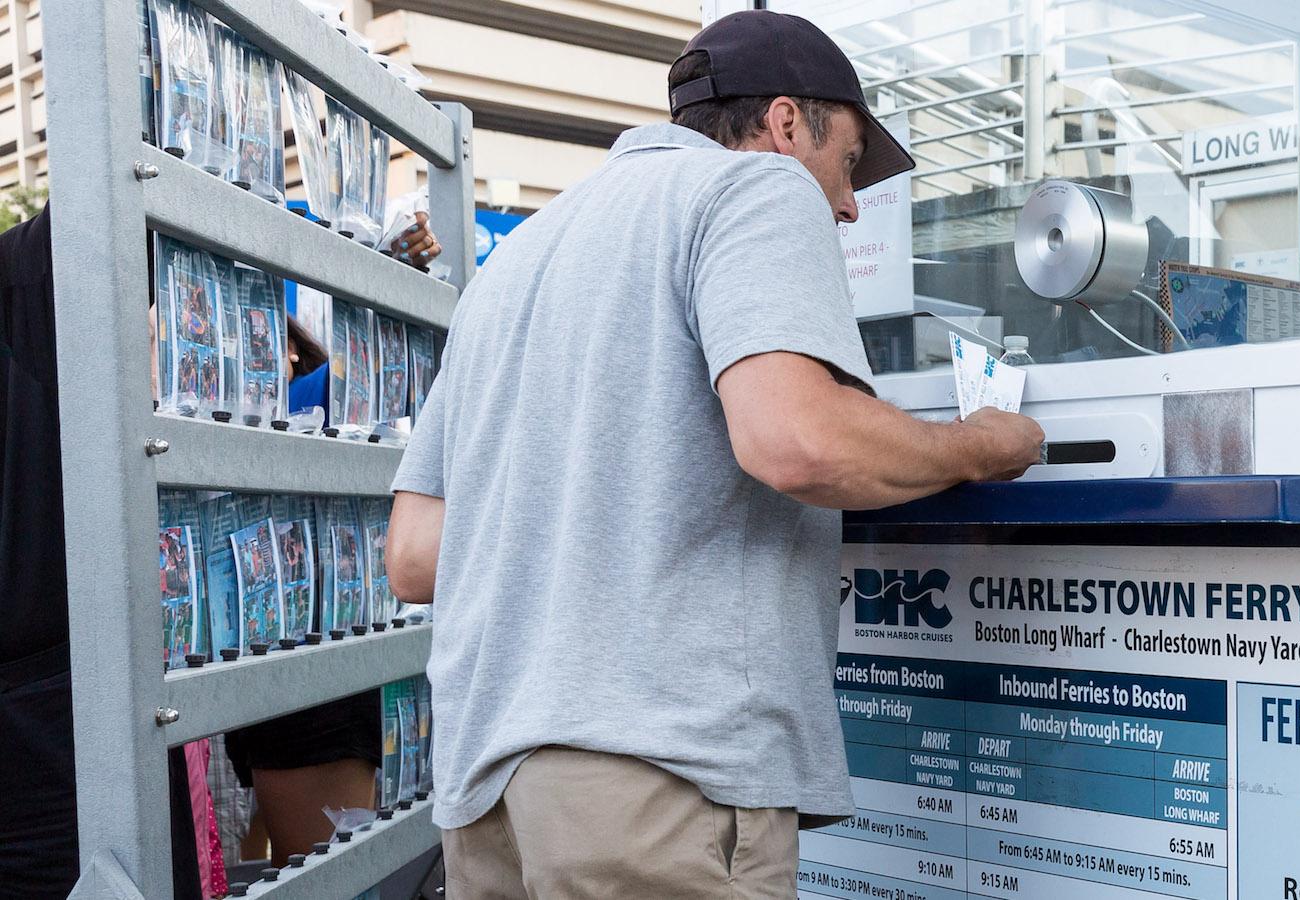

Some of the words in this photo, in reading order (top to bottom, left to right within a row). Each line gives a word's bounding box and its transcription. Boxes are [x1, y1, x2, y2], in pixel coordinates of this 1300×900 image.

[1193, 131, 1259, 163] LONG
[863, 192, 898, 209] SHUTTLE
[860, 245, 877, 256] PIER
[848, 264, 878, 279] WHARF
[854, 569, 953, 629] BHC
[969, 576, 1195, 617] CHARLESTOWN
[855, 629, 885, 639] BOSTON
[887, 630, 919, 640] HARBOR
[921, 632, 953, 642] CRUISES
[975, 621, 1020, 644] Boston
[1024, 623, 1056, 651] Long
[1061, 625, 1106, 649] Wharf
[1125, 628, 1221, 656] Charlestown
[1226, 633, 1267, 665] Navy
[870, 663, 898, 685] from
[901, 667, 944, 689] Boston
[1000, 674, 1057, 700] Inbound
[1061, 679, 1110, 705] Ferries
[1113, 685, 1129, 706] to
[1132, 684, 1186, 711] Boston
[840, 695, 879, 718] through
[881, 699, 912, 722] Friday
[921, 731, 950, 750] ARRIVE
[1020, 712, 1067, 739] Monday
[1070, 717, 1120, 744] through
[1123, 723, 1163, 750] Friday
[978, 737, 1011, 757] DEPART
[910, 754, 960, 771] CHARLESTOWN
[969, 761, 1022, 779] CHARLESTOWN
[1172, 759, 1210, 782] ARRIVE
[917, 772, 934, 785] NAVY
[935, 774, 953, 787] YARD
[976, 780, 995, 794] NAVY
[995, 781, 1015, 796] YARD
[917, 796, 936, 810] 6:40
[938, 798, 953, 813] AM
[1174, 787, 1209, 804] BOSTON
[980, 805, 1001, 821] 6:45
[1002, 808, 1017, 824] AM
[1164, 806, 1188, 820] LONG
[1189, 809, 1219, 824] WHARF
[850, 817, 855, 829] 9
[857, 818, 870, 831] AM
[871, 823, 892, 838] every
[895, 824, 905, 837] 15
[907, 826, 929, 841] mins.
[1169, 837, 1193, 855] 6:55
[1196, 841, 1214, 859] AM
[918, 860, 936, 876] 9:10
[938, 863, 953, 879] AM
[999, 840, 1021, 858] From
[1024, 846, 1043, 860] 6:45
[1045, 848, 1060, 864] AM
[1064, 852, 1073, 866] to
[1075, 854, 1096, 871] 9:15
[1098, 857, 1115, 874] AM
[1117, 863, 1145, 882] every
[1148, 866, 1159, 881] 15
[1162, 868, 1190, 886] mins.
[811, 871, 816, 883] 9
[817, 873, 829, 887] AM
[831, 878, 839, 888] to
[840, 877, 857, 891] 3:30
[858, 882, 871, 895] PM
[872, 886, 893, 900] every
[981, 871, 1001, 887] 9:15
[1002, 875, 1018, 891] AM
